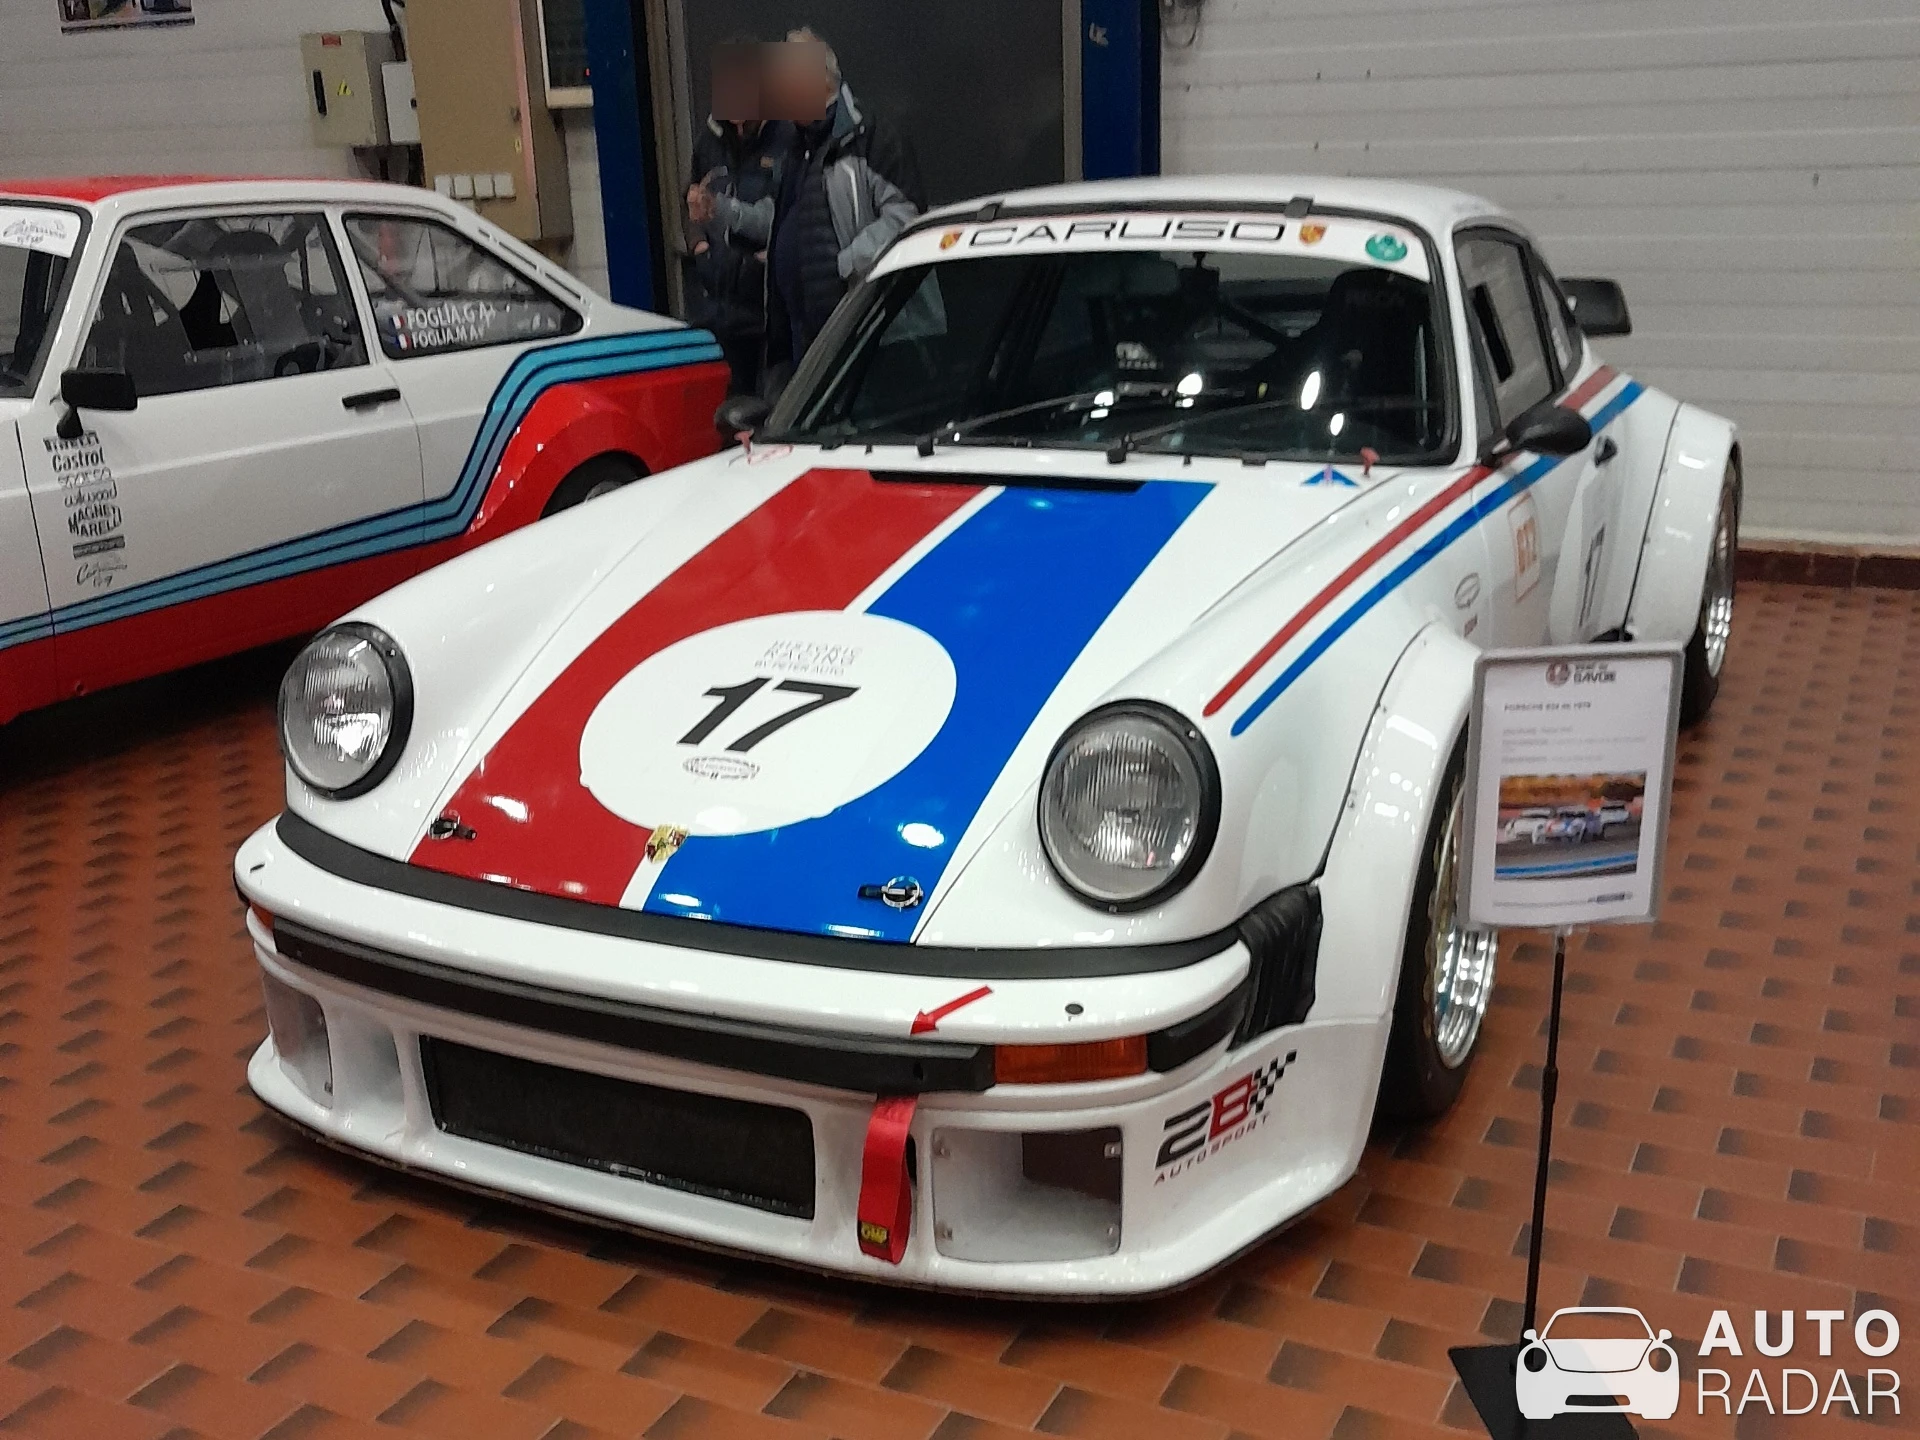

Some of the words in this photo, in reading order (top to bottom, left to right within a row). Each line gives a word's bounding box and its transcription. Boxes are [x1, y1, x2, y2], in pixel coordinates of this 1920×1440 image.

[968, 218, 1286, 248] CARUSO
[52, 446, 105, 473] Castrol
[677, 677, 861, 752] 17
[1153, 1111, 1271, 1186] AUTOSPORT
